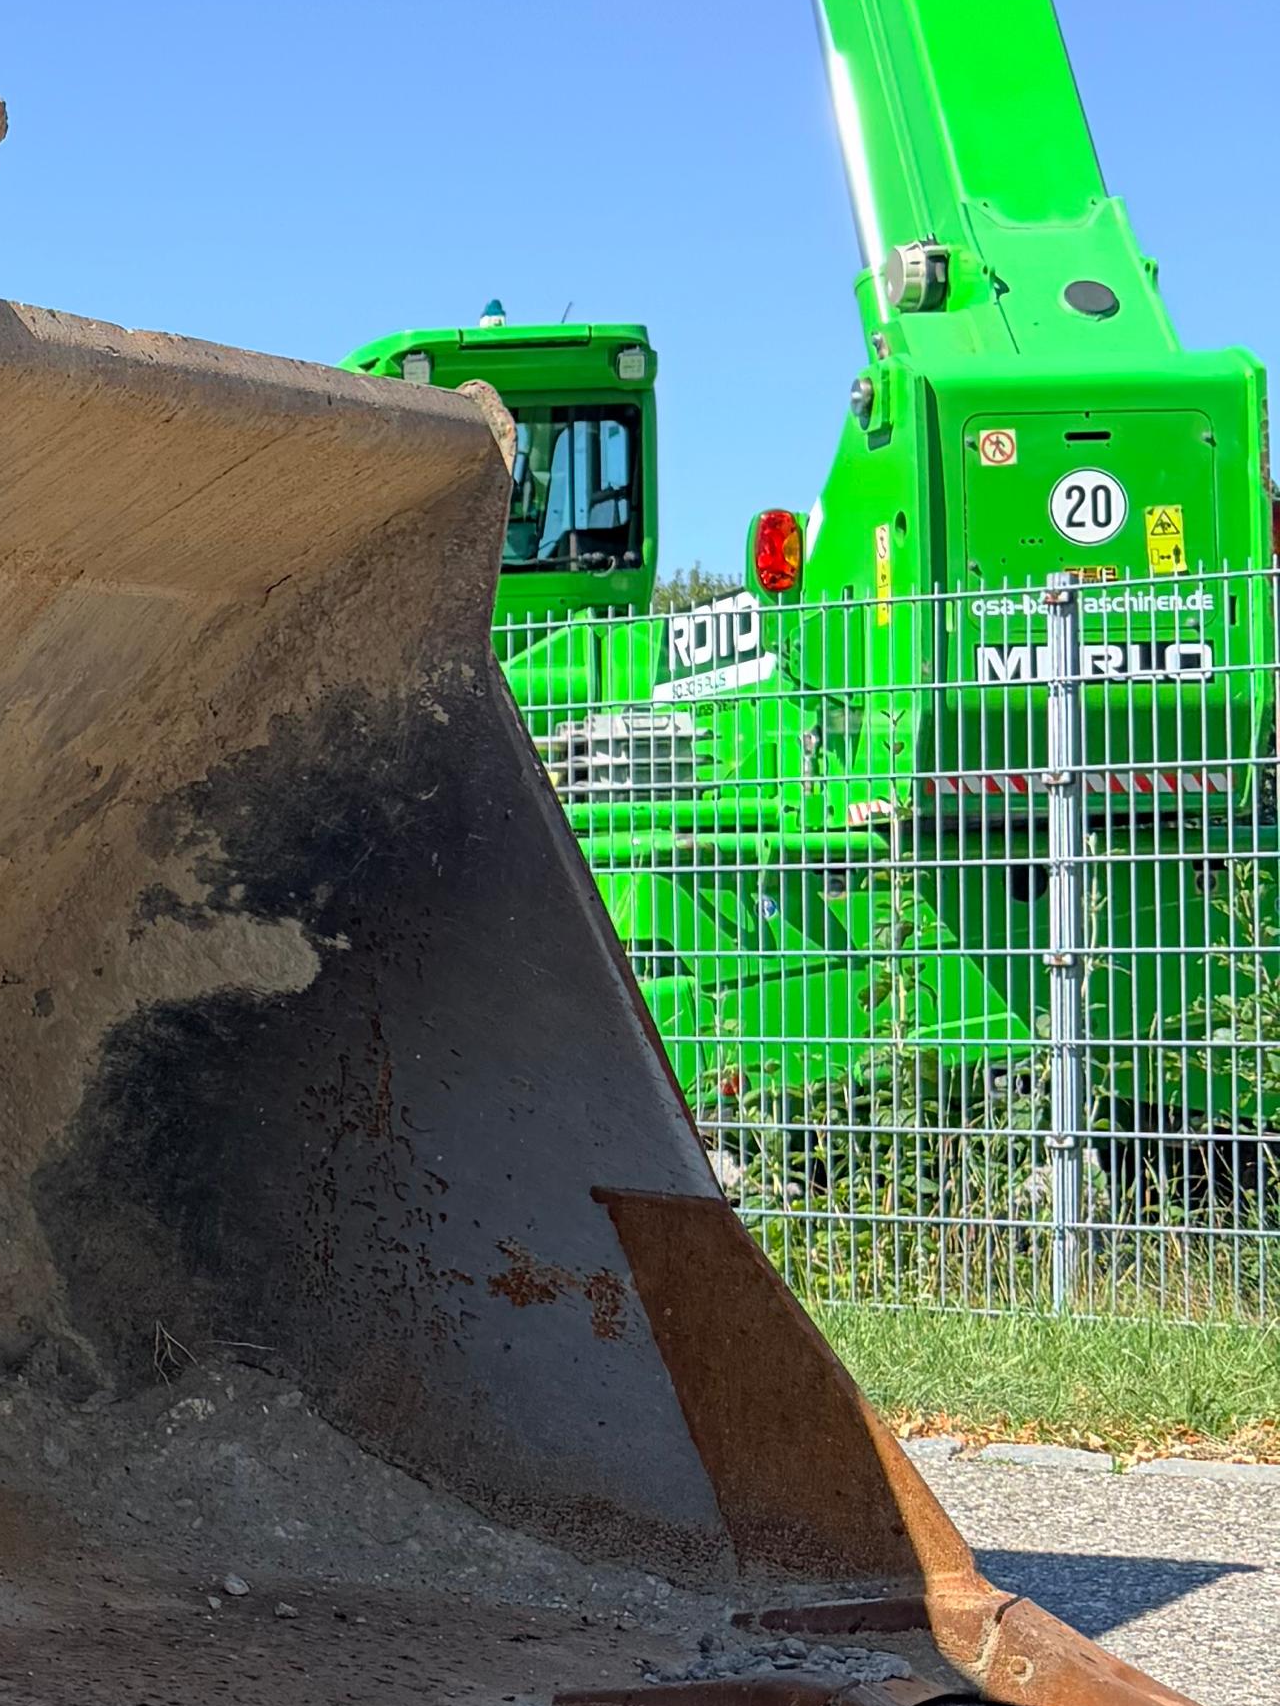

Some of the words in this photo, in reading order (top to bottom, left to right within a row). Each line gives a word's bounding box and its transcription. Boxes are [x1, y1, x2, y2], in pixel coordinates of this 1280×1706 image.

[1065, 484, 1112, 528] 20
[971, 591, 1214, 616] osa-baaschinen.de
[668, 591, 759, 671] ROTO
[976, 643, 1213, 682] MRLO
